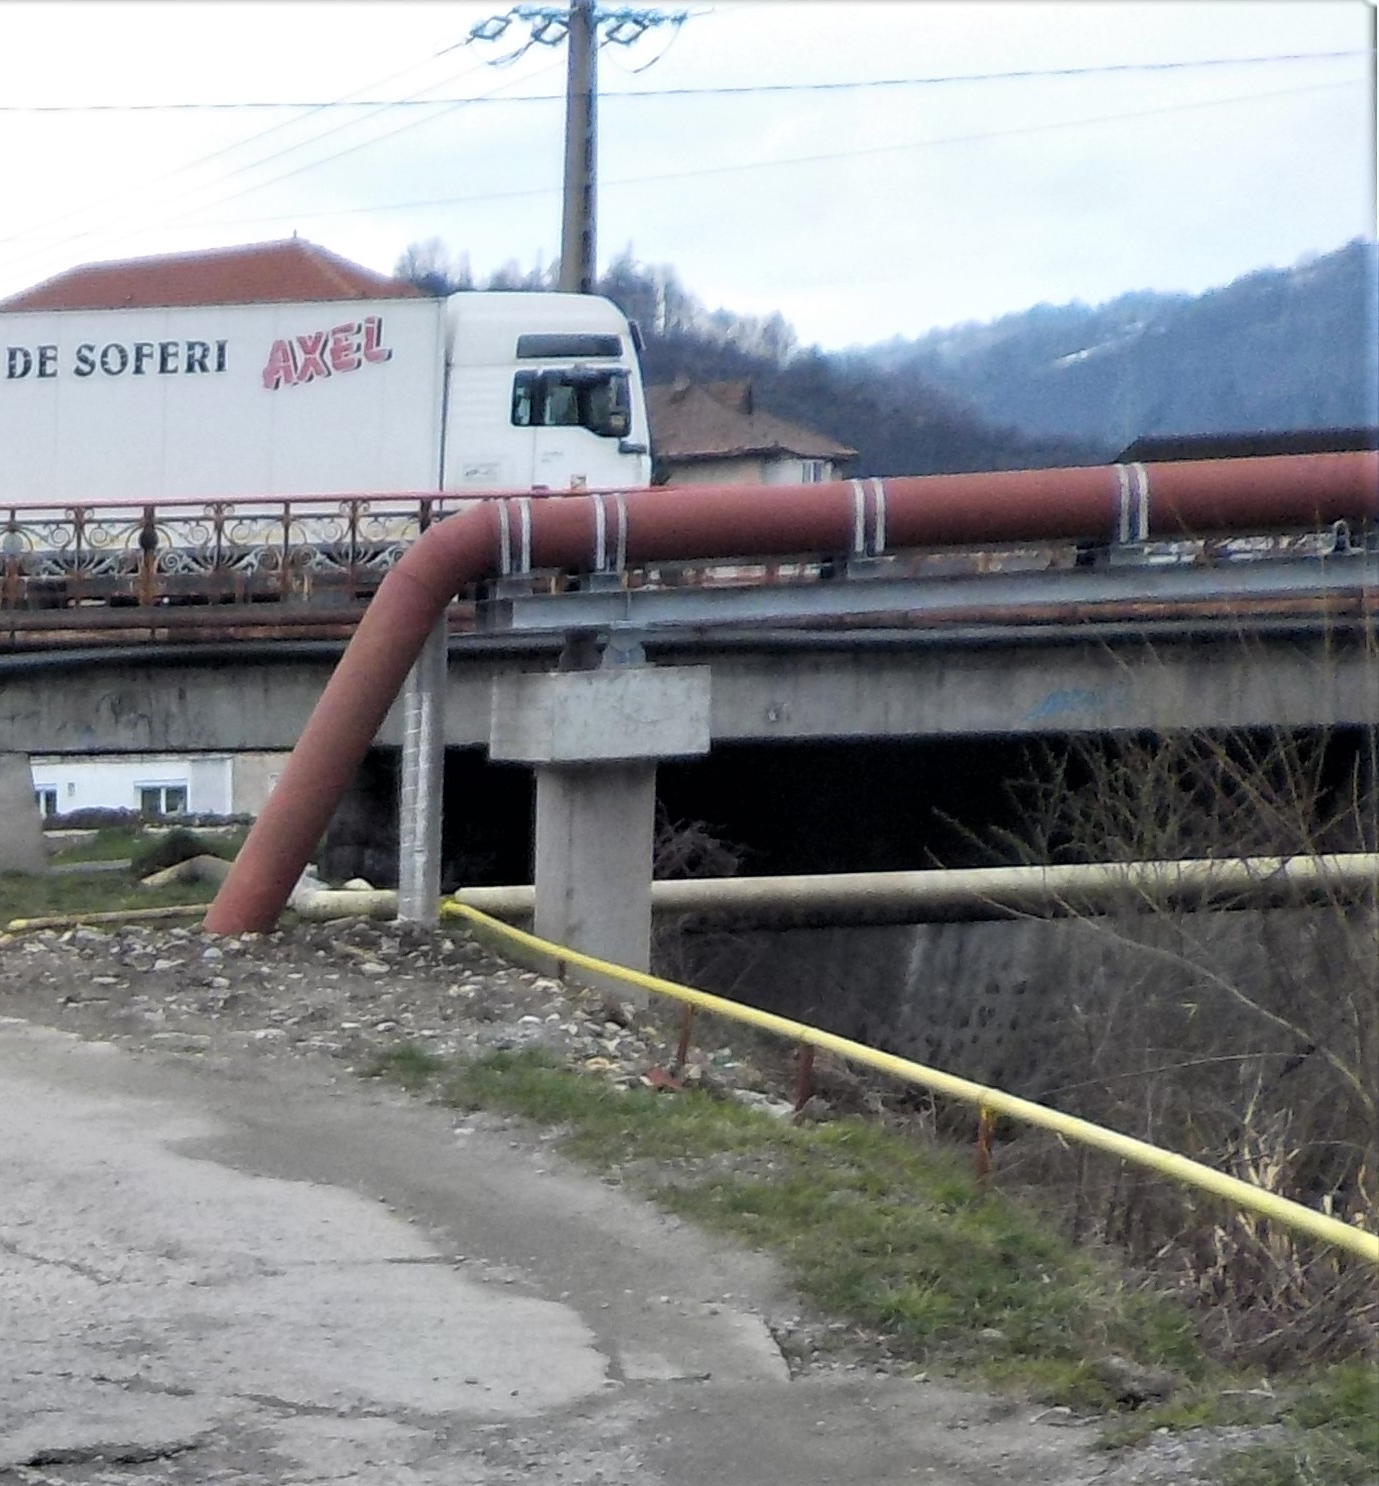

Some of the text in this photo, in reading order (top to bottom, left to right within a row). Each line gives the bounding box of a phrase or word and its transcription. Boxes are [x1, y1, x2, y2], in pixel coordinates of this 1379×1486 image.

[6, 344, 59, 379] DE
[73, 339, 229, 377] SOFERI
[262, 315, 392, 391] AXEL
